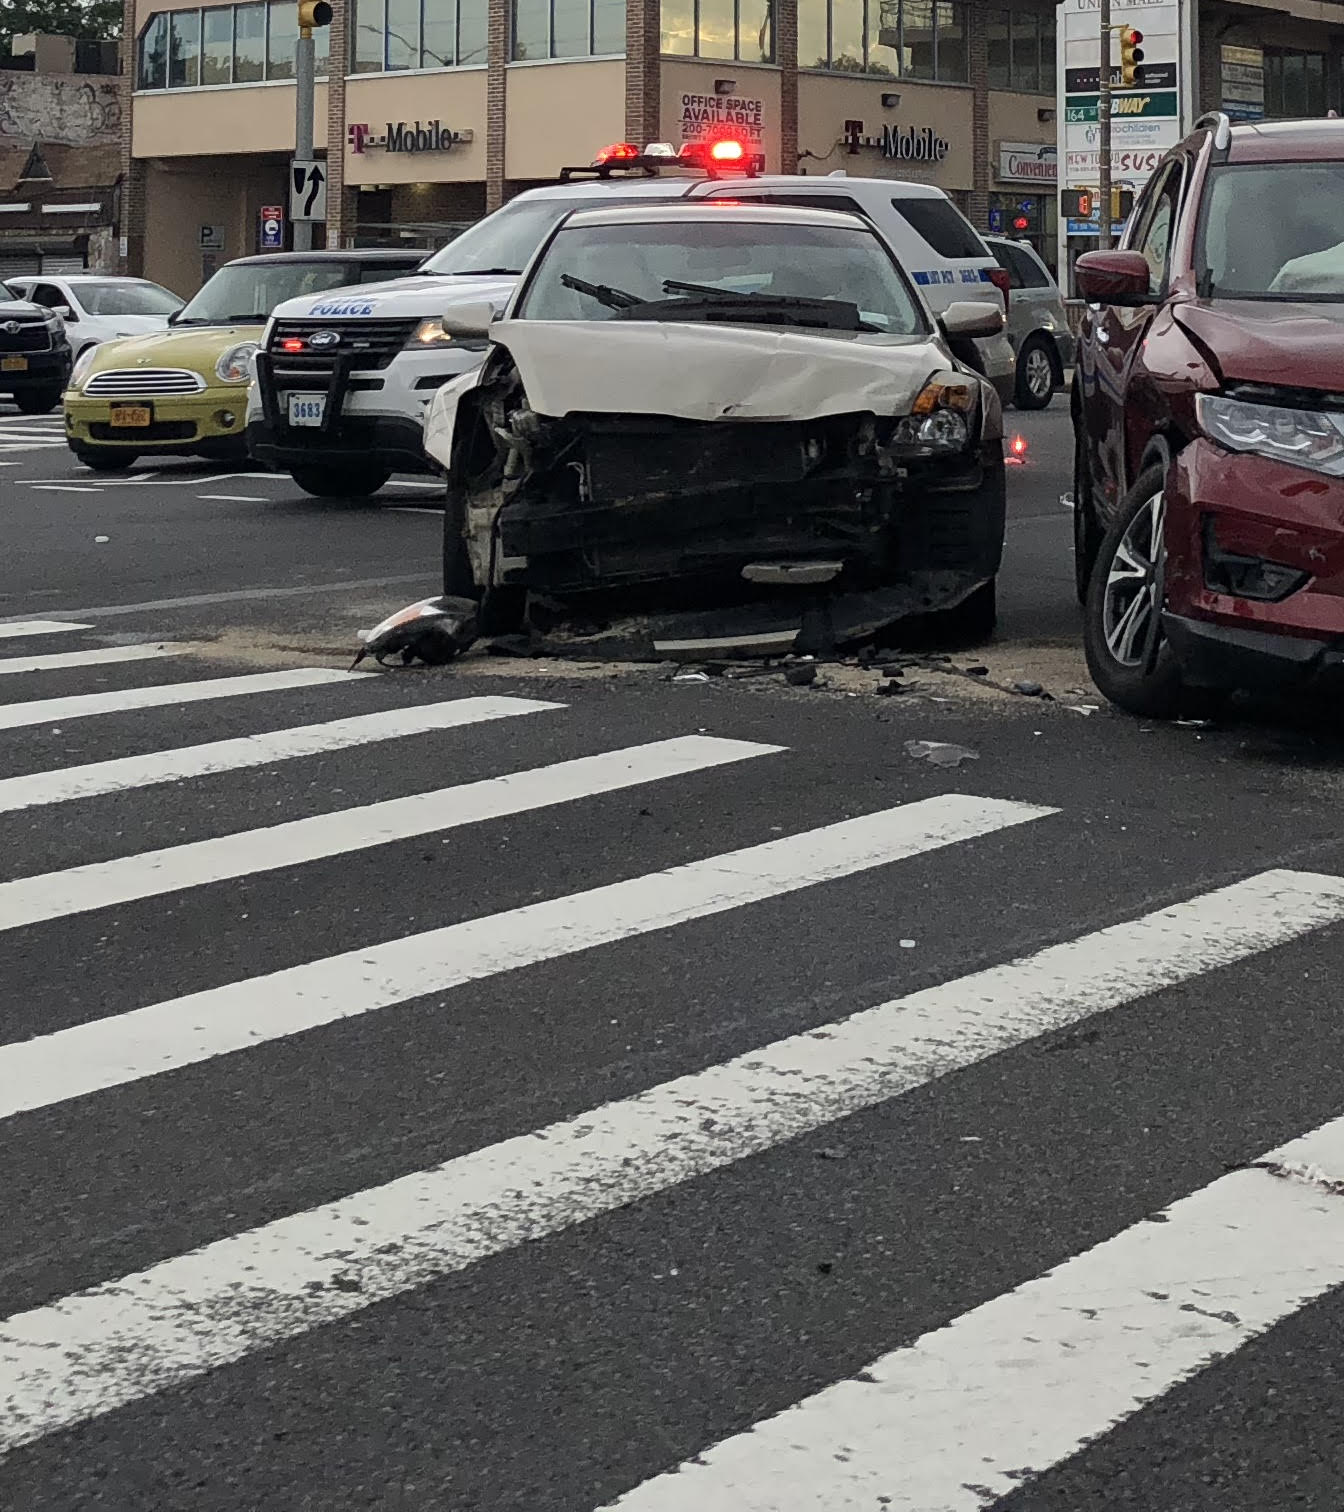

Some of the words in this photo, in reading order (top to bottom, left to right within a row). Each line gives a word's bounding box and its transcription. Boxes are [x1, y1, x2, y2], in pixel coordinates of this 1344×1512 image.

[682, 94, 723, 109] OFFICE
[725, 98, 762, 112] SPACE
[1096, 97, 1151, 114] BWAY
[682, 107, 762, 126] AVAILABLE
[1066, 109, 1085, 121] 164
[201, 226, 214, 244] P
[308, 303, 375, 316] POLICE
[293, 402, 321, 418] 3683
